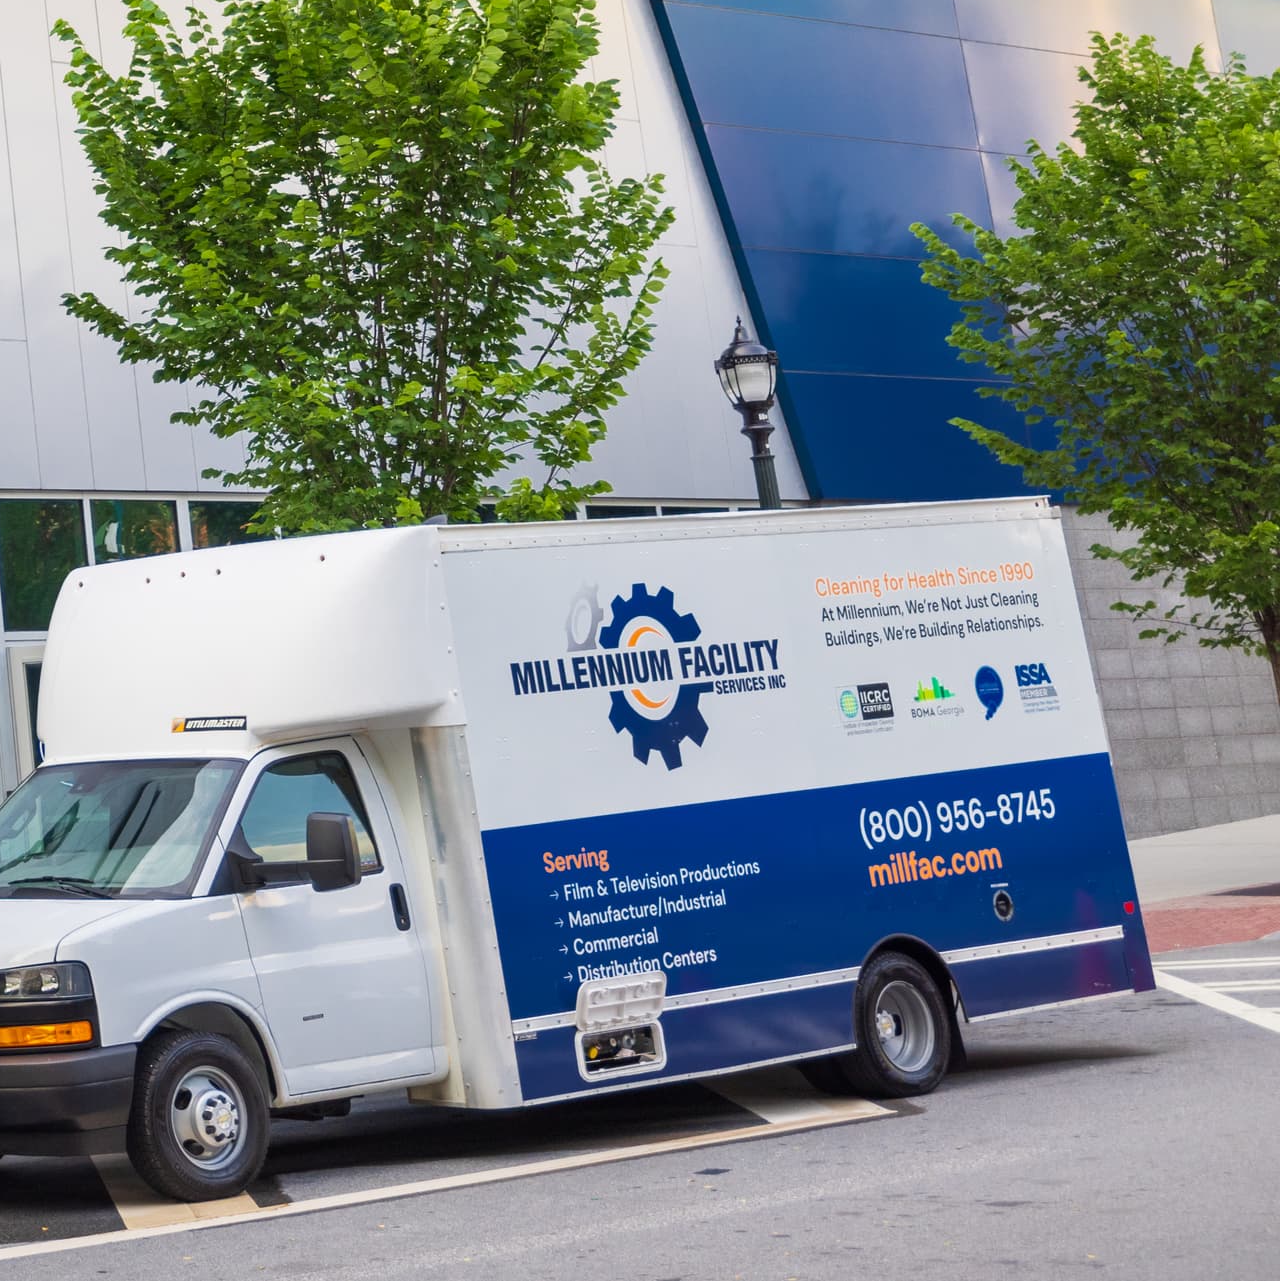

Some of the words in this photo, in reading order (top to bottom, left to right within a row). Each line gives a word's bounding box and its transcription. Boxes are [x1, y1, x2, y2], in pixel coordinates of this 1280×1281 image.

[816, 576, 882, 598] Cleaning
[884, 573, 904, 591] for
[907, 568, 955, 590] Health
[958, 565, 997, 585] Since
[1000, 562, 1033, 582] 1990
[821, 607, 835, 622] At
[836, 602, 904, 620] Millennium,
[941, 596, 963, 612] Not
[965, 594, 989, 610] Just
[990, 590, 1039, 608] Cleaning
[825, 629, 883, 648] Buildings,
[918, 622, 965, 639] Building
[967, 614, 1044, 634] Relationships.
[510, 648, 673, 696] MILLENNIUM
[678, 639, 779, 679] FACILITY
[1015, 663, 1051, 687] ISSA
[715, 676, 766, 695] SERVICES
[768, 674, 786, 690] INC
[860, 689, 890, 704] IICRC
[1022, 688, 1048, 698] MEMBER
[863, 704, 891, 713] CERTIFIED
[911, 708, 935, 719] BOMA
[937, 705, 965, 718] Georgia
[859, 800, 932, 850] (800)
[936, 788, 1056, 834] 956-8745
[543, 847, 610, 873] Serving
[868, 847, 1003, 888] millfac.com
[563, 882, 594, 902] Film
[597, 879, 608, 896] &
[610, 872, 678, 894] Television
[680, 860, 760, 885] Productions
[568, 888, 726, 928] Manufacture/Industrial
[573, 926, 659, 955] Commercial
[577, 956, 661, 983] Distribution
[663, 946, 718, 969] Centers
